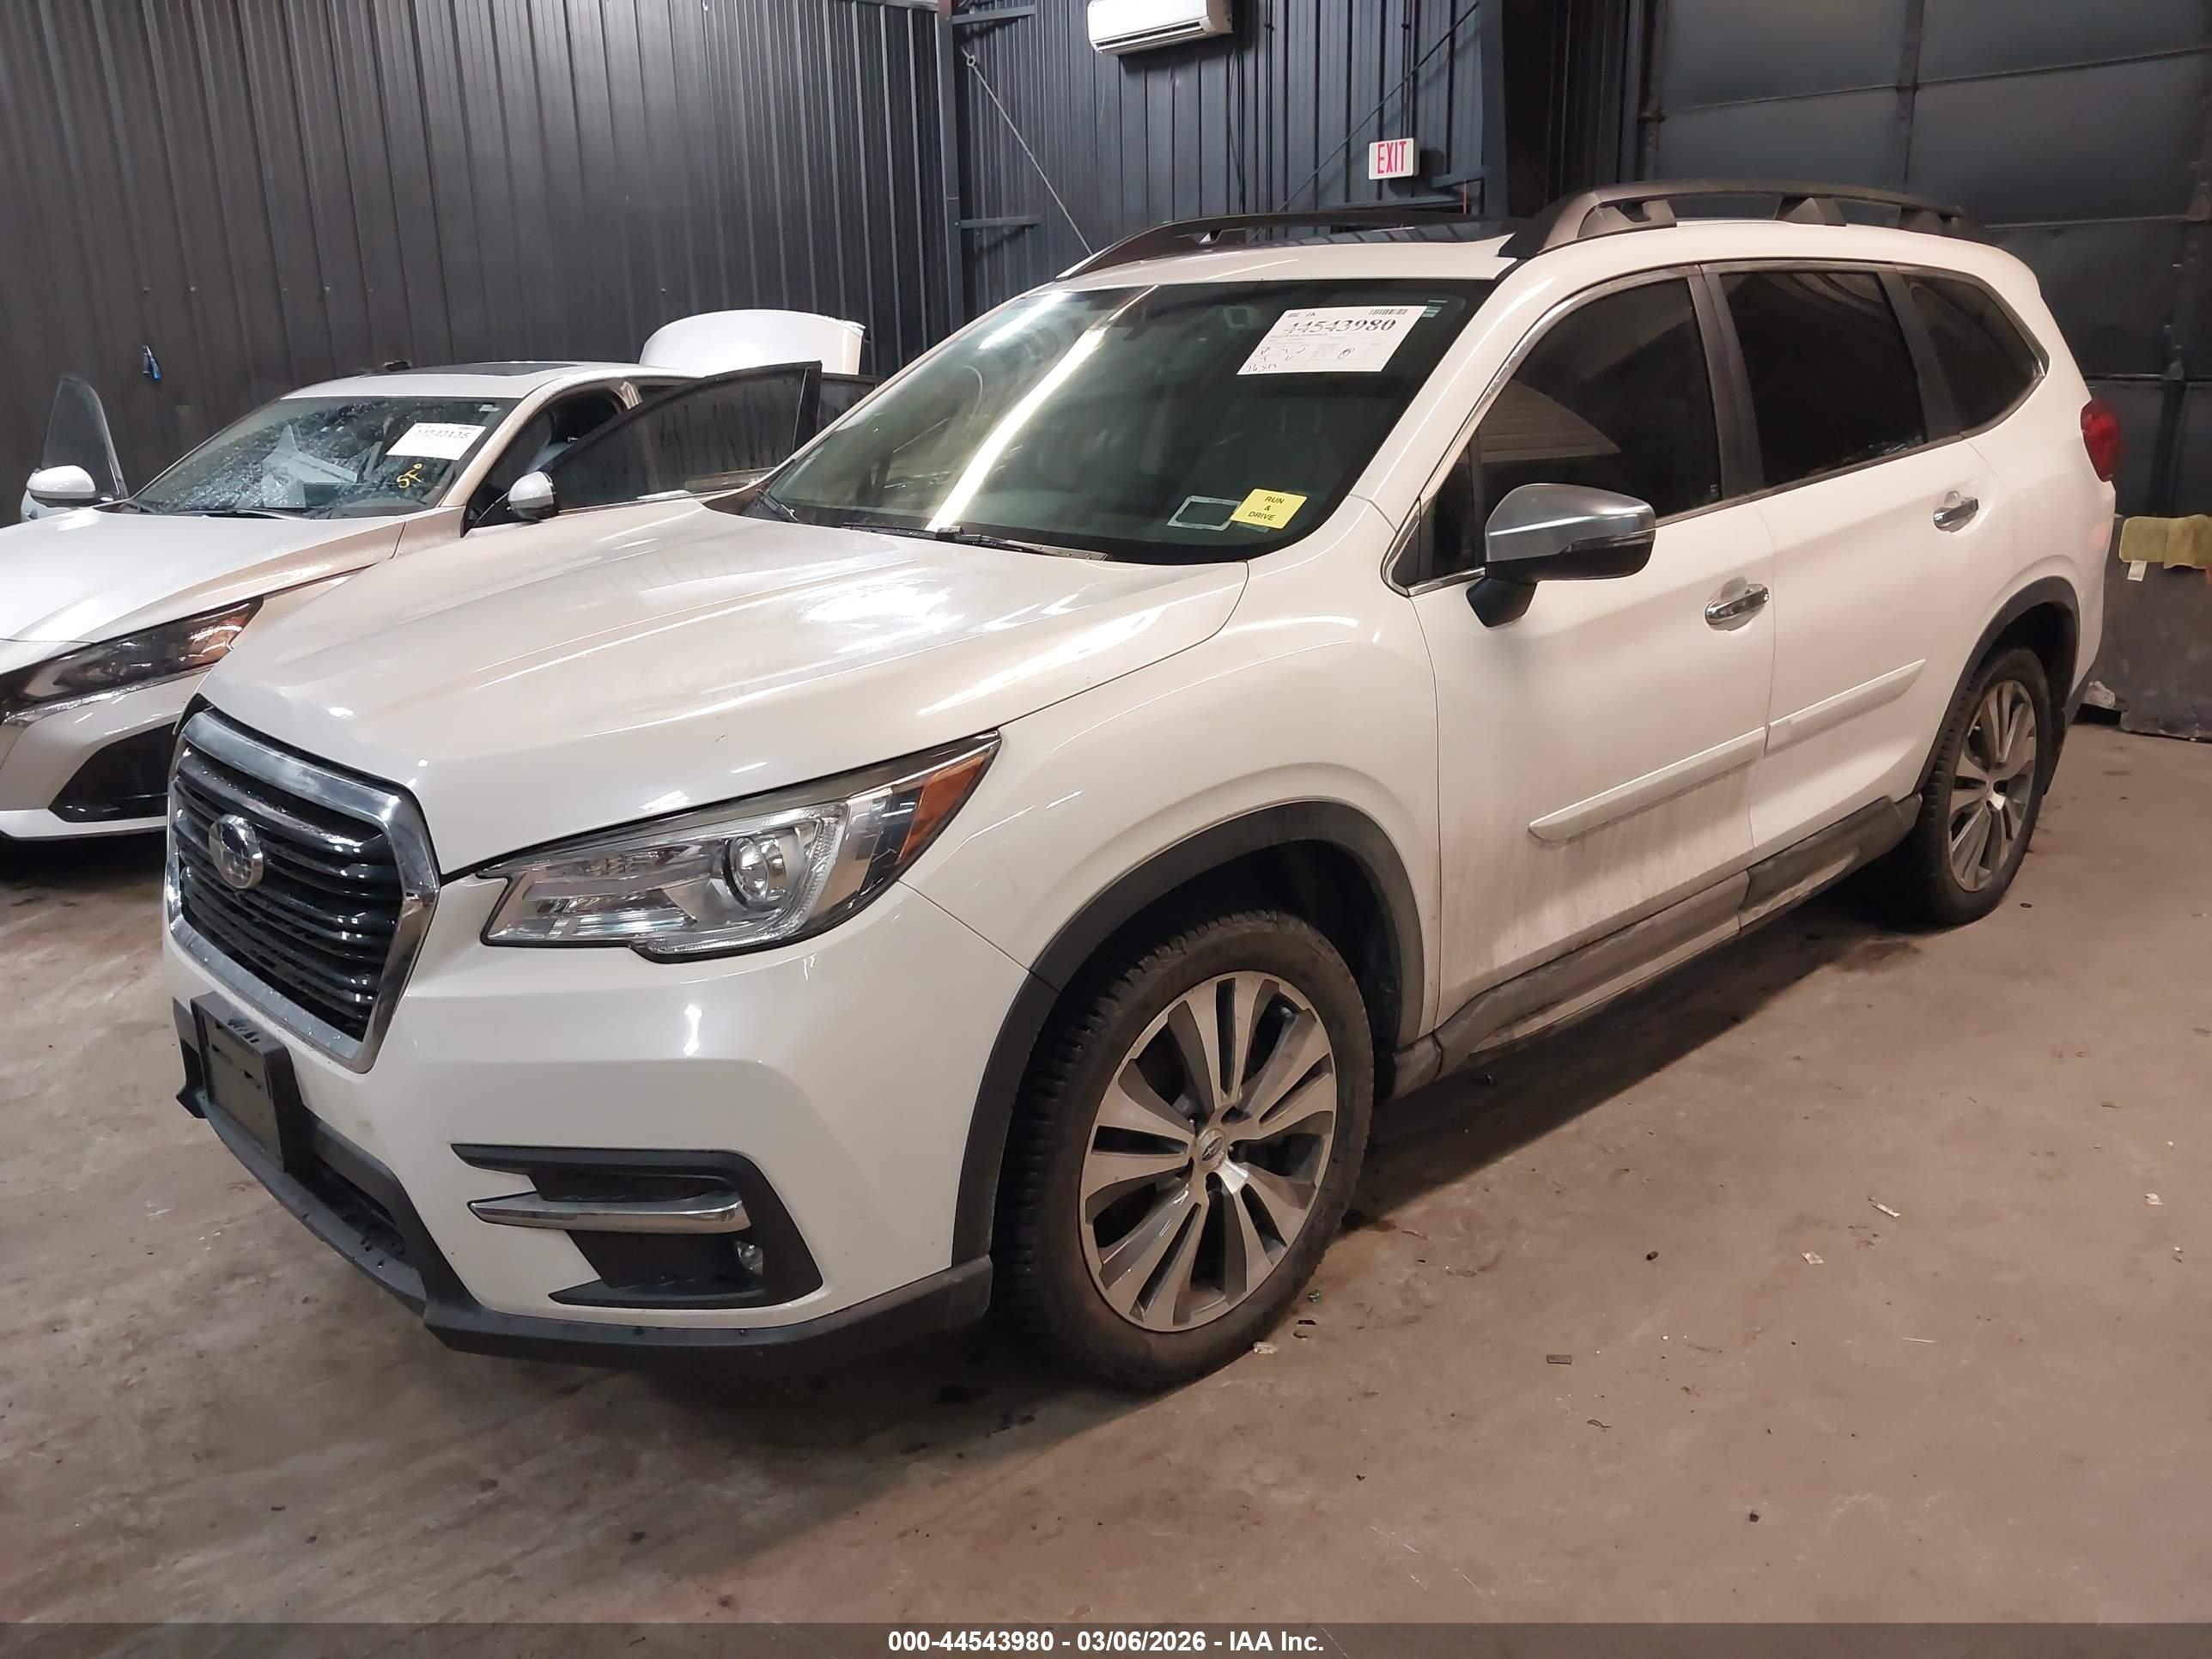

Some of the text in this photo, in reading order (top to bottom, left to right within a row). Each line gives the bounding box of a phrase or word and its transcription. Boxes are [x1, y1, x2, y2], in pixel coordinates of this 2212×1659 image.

[1377, 141, 1407, 174] EXIT
[1284, 319, 1397, 334] 44543980
[1264, 495, 1285, 504] RUN
[1248, 511, 1277, 521] DRIVE
